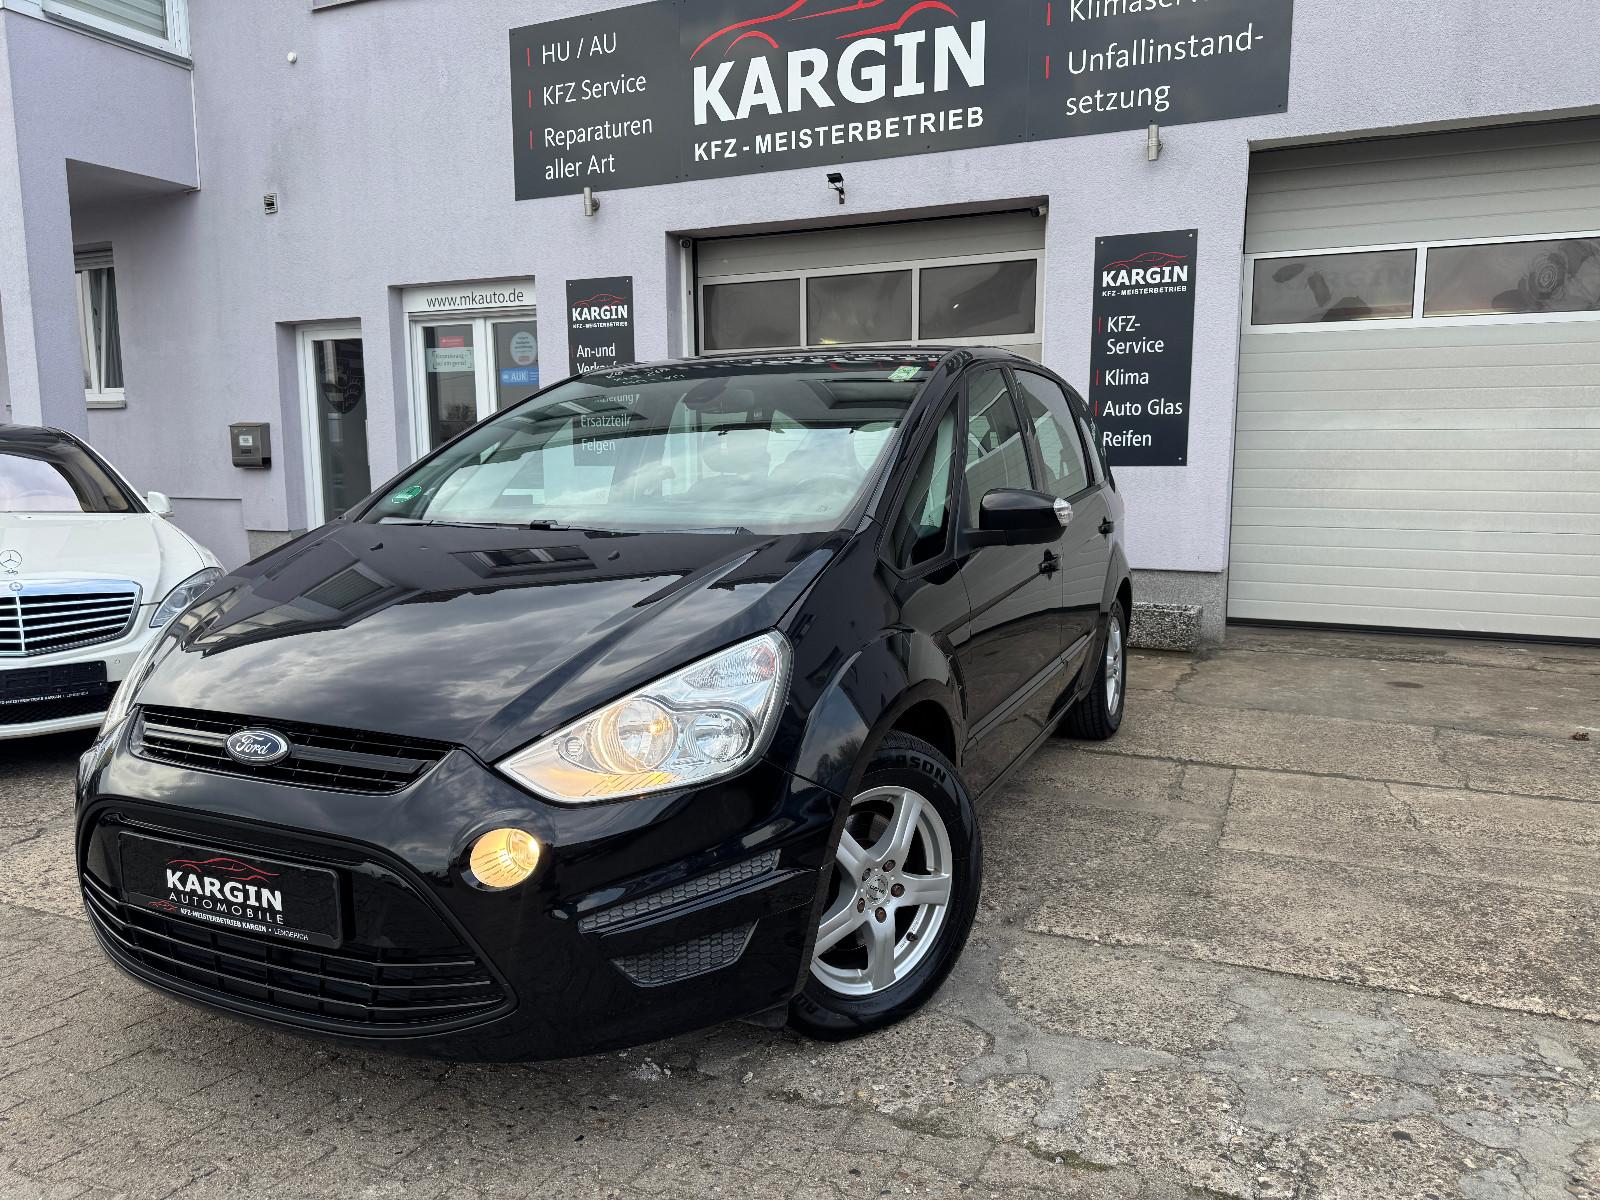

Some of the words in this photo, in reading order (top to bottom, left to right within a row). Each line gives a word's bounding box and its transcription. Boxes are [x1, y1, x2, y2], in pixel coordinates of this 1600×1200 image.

[542, 41, 576, 65] HU
[577, 38, 584, 57] /
[589, 32, 617, 56] AU
[1068, 22, 1264, 75] Unfallinstand-
[693, 19, 986, 126] KARGIN
[542, 82, 576, 106] KFZ
[581, 73, 647, 100] Service
[1065, 85, 1171, 116] setzung
[544, 116, 653, 151] Reparaturen
[545, 156, 582, 180] aller
[587, 153, 616, 175] Art
[1102, 265, 1188, 287] KARGIN
[426, 287, 524, 308] www.mkauto.de
[572, 304, 628, 321] KARGIN
[1107, 315, 1141, 333] KFZ-
[576, 342, 616, 358] An-und
[1106, 337, 1165, 355] Service
[1105, 369, 1149, 386] Klima
[1102, 400, 1142, 417] Auto
[1147, 398, 1183, 415] Glas
[581, 438, 616, 454] Felgen
[1102, 429, 1152, 447] Reifen
[236, 735, 269, 755] Ford
[166, 868, 283, 912] KARGIN
[169, 891, 284, 925] AUTOMOBILE
[241, 921, 267, 933] KARGIN
